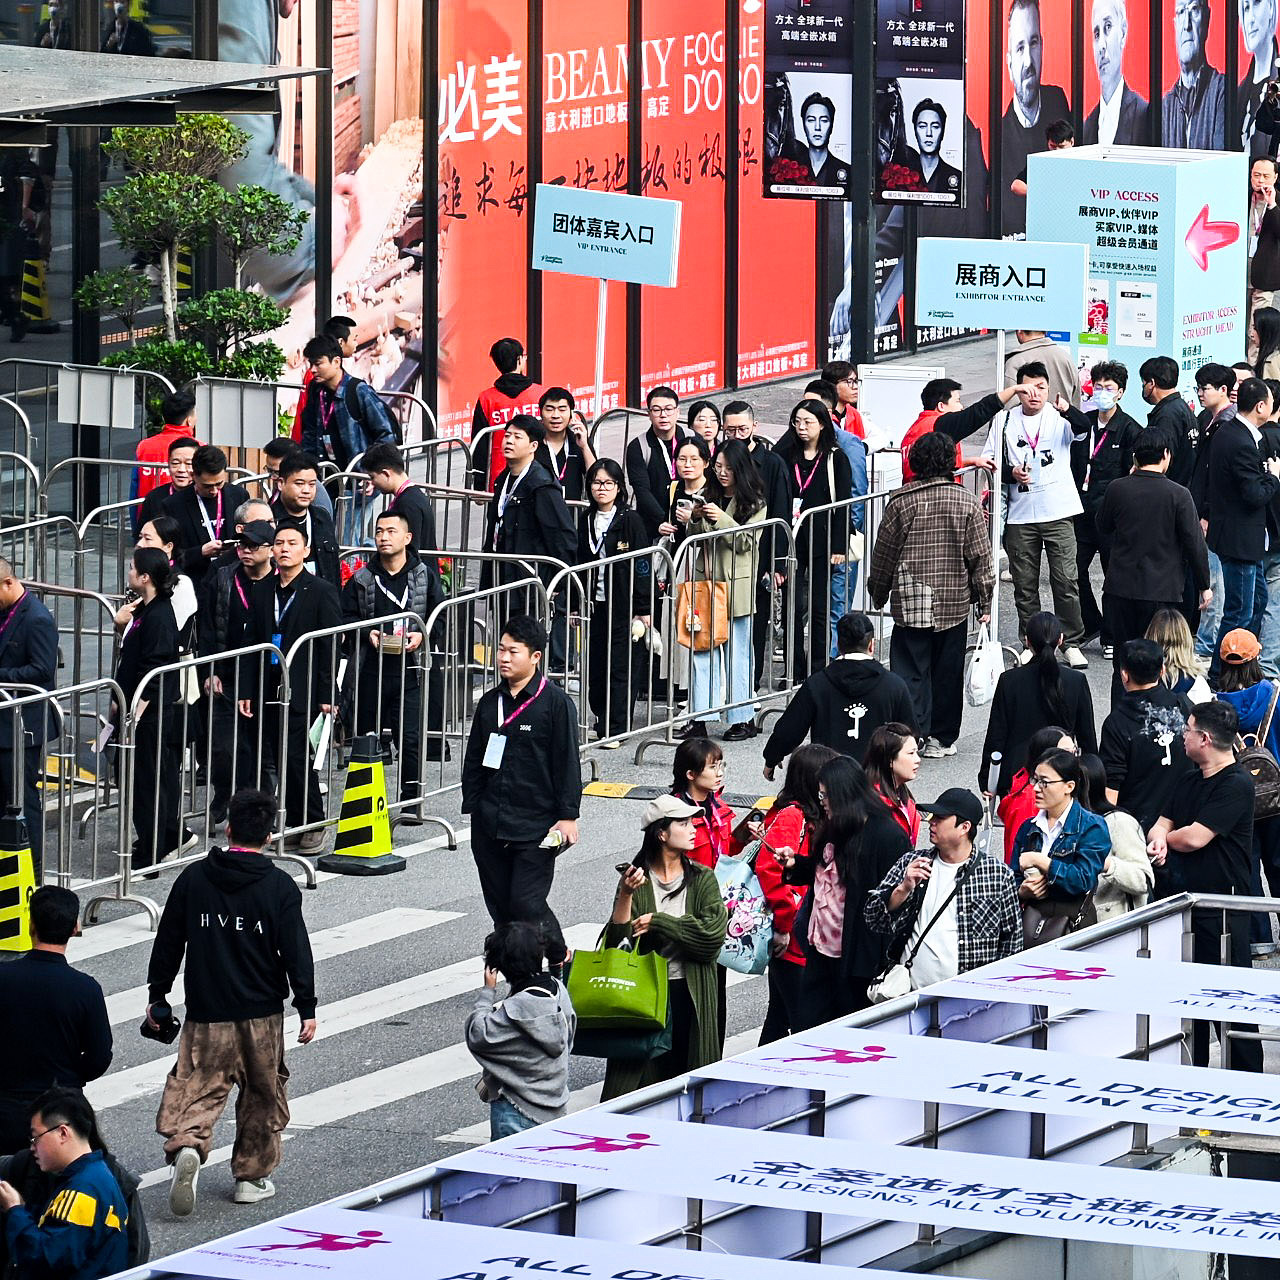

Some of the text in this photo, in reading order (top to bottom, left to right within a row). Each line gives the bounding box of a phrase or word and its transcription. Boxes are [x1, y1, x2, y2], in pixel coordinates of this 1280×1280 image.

[775, 14, 844, 27] 方太 全球新一代
[886, 20, 955, 33] 方太 全球新一代
[781, 31, 838, 43] 高端全嵌冰箱
[892, 36, 949, 49] 高端全嵌冰箱
[438, 25, 759, 145] 必美 BEAMY FOGIE
[684, 63, 761, 115] D'OO
[545, 102, 629, 134] 意大利进口地板
[1090, 188, 1159, 202] VIP ACCESS
[1079, 205, 1159, 220] 展商VIP、伙伴VIP
[553, 212, 654, 245] 团体嘉宾入口
[1095, 221, 1159, 235] 买家VIP、媒体
[577, 242, 628, 256] VIP ENTRANCE
[1096, 235, 1158, 251] 超级会员通道
[955, 263, 1047, 289] 展商入口
[956, 292, 1047, 303] EXHIBITOR ENTRANCE
[1169, 998, 1217, 1009] ALL
[983, 1070, 1082, 1089] ALL
[948, 1081, 1050, 1100] ALL
[1066, 1094, 1131, 1108] IN
[714, 1173, 770, 1188] ALL
[777, 1181, 920, 1208] DESIGNS,
[928, 1198, 985, 1213] ALL
[990, 1206, 1182, 1234] SOLUTIONS,
[1190, 1224, 1250, 1239] ALL
[481, 1255, 593, 1277] ALL
